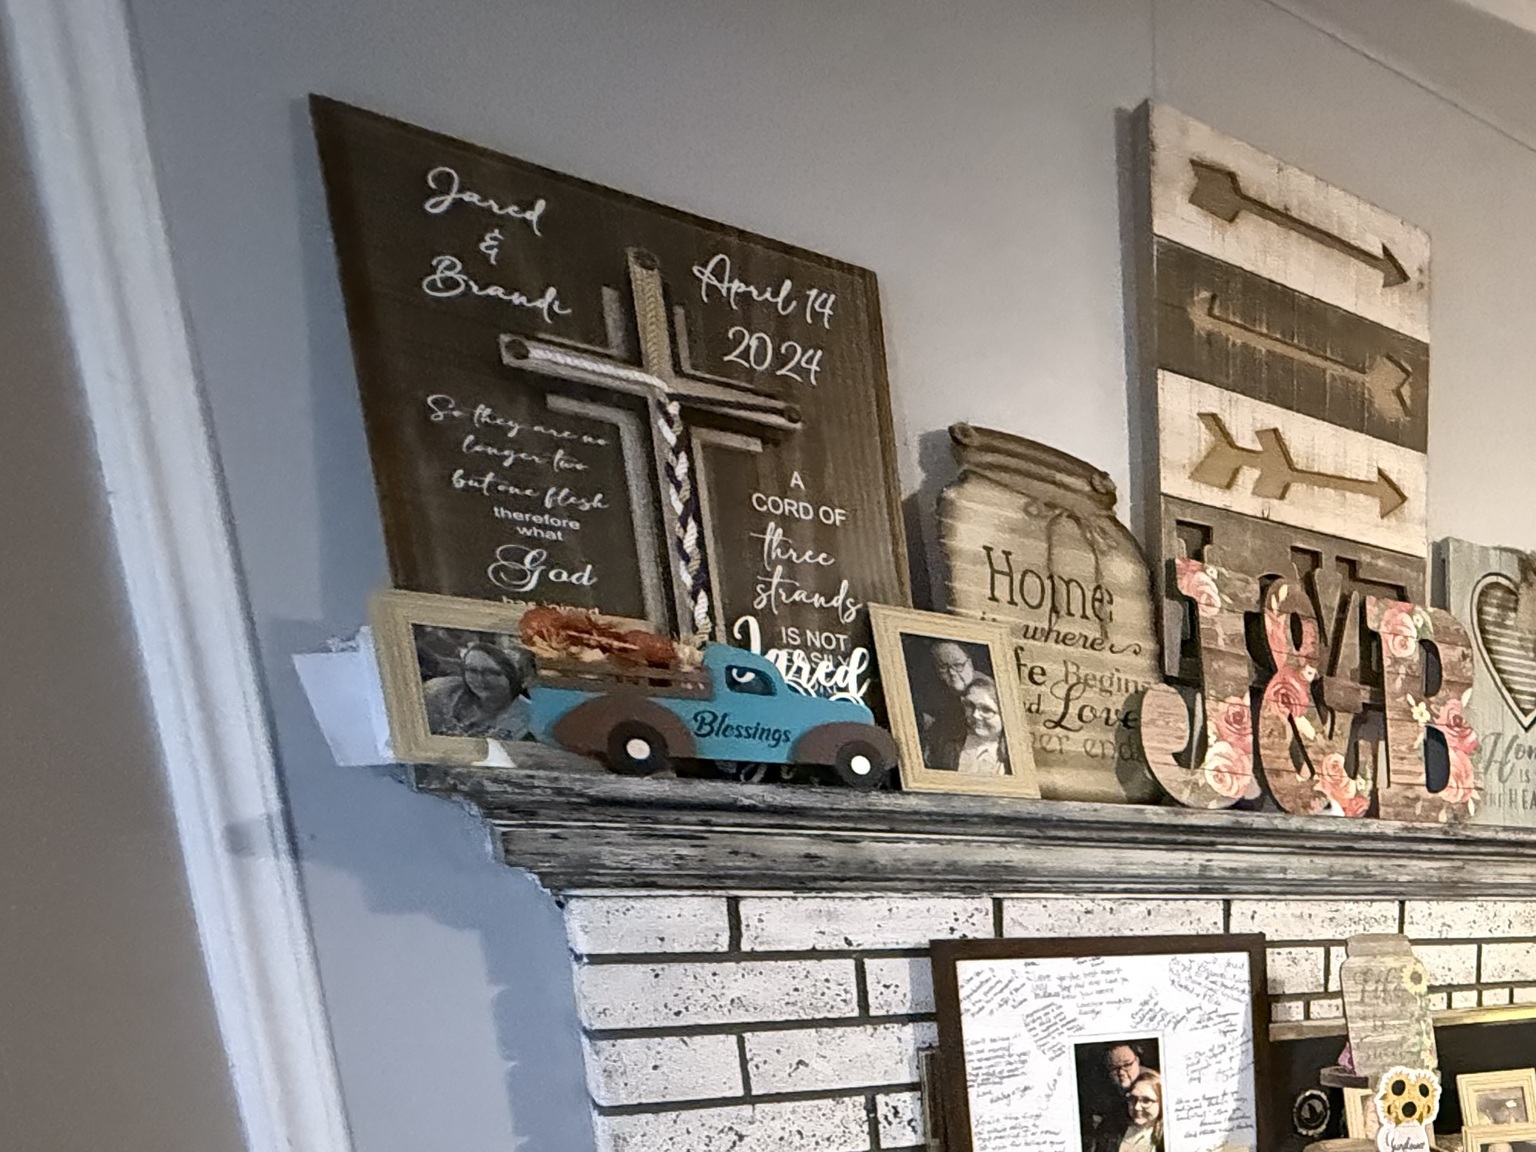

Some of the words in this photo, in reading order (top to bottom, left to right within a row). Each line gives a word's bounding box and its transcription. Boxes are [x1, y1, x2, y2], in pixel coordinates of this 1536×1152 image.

[424, 167, 546, 236] Jared
[479, 229, 504, 264] &
[692, 254, 797, 316] April
[805, 288, 837, 329] 14
[723, 326, 822, 385] 2024
[427, 394, 463, 421] So
[473, 404, 521, 437] they
[533, 425, 577, 438] are
[582, 434, 609, 446] no
[462, 434, 543, 467] longer
[553, 449, 589, 472] two
[451, 469, 497, 496] but
[497, 484, 540, 497] one
[544, 487, 610, 510] flesh
[789, 471, 805, 490] A
[493, 506, 581, 530] therefore
[751, 492, 814, 521] CORD
[818, 505, 849, 527] OF
[516, 526, 564, 541] what
[750, 521, 836, 572] three
[487, 544, 598, 592] God
[982, 545, 1114, 623] Home
[753, 564, 864, 625] strands
[781, 626, 802, 647] IS
[806, 629, 851, 652] NOT
[1022, 623, 1107, 652] where
[1042, 679, 1139, 733] Love
[693, 709, 792, 748] Blessings
